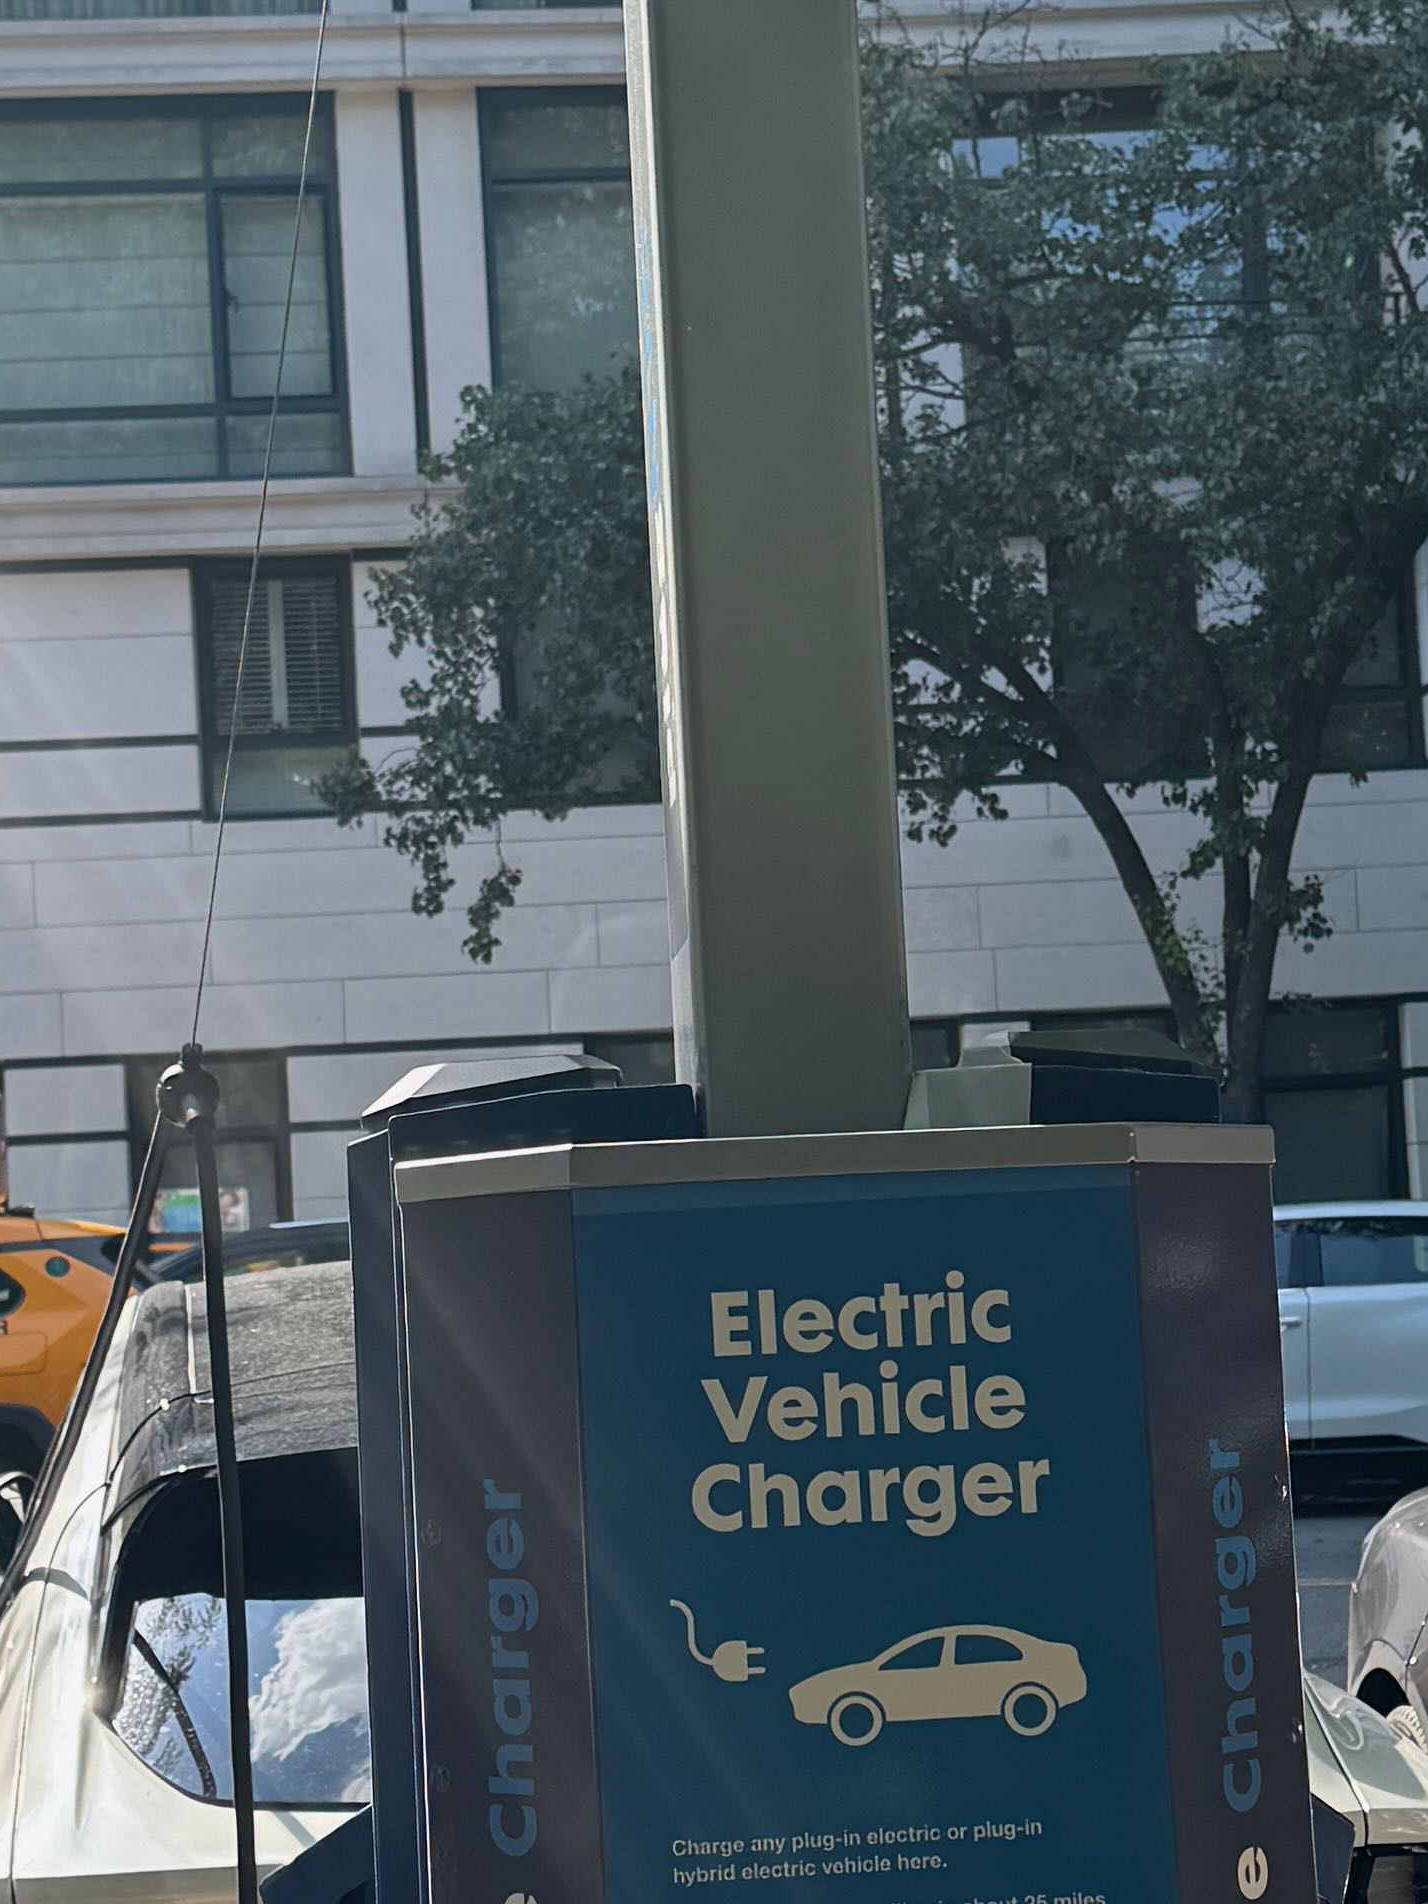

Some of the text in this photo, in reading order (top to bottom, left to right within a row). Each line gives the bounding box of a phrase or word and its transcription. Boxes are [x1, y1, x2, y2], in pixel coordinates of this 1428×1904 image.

[711, 1271, 1011, 1356] Electric
[701, 1360, 1025, 1442] Vehicle
[692, 1459, 1049, 1536] Charger
[1209, 1438, 1262, 1813] Charger
[483, 1478, 539, 1857] Charger
[673, 1819, 1041, 1857] Charge any plug-in electric or plug-in
[674, 1854, 947, 1887] hybrid electric vehicle here.
